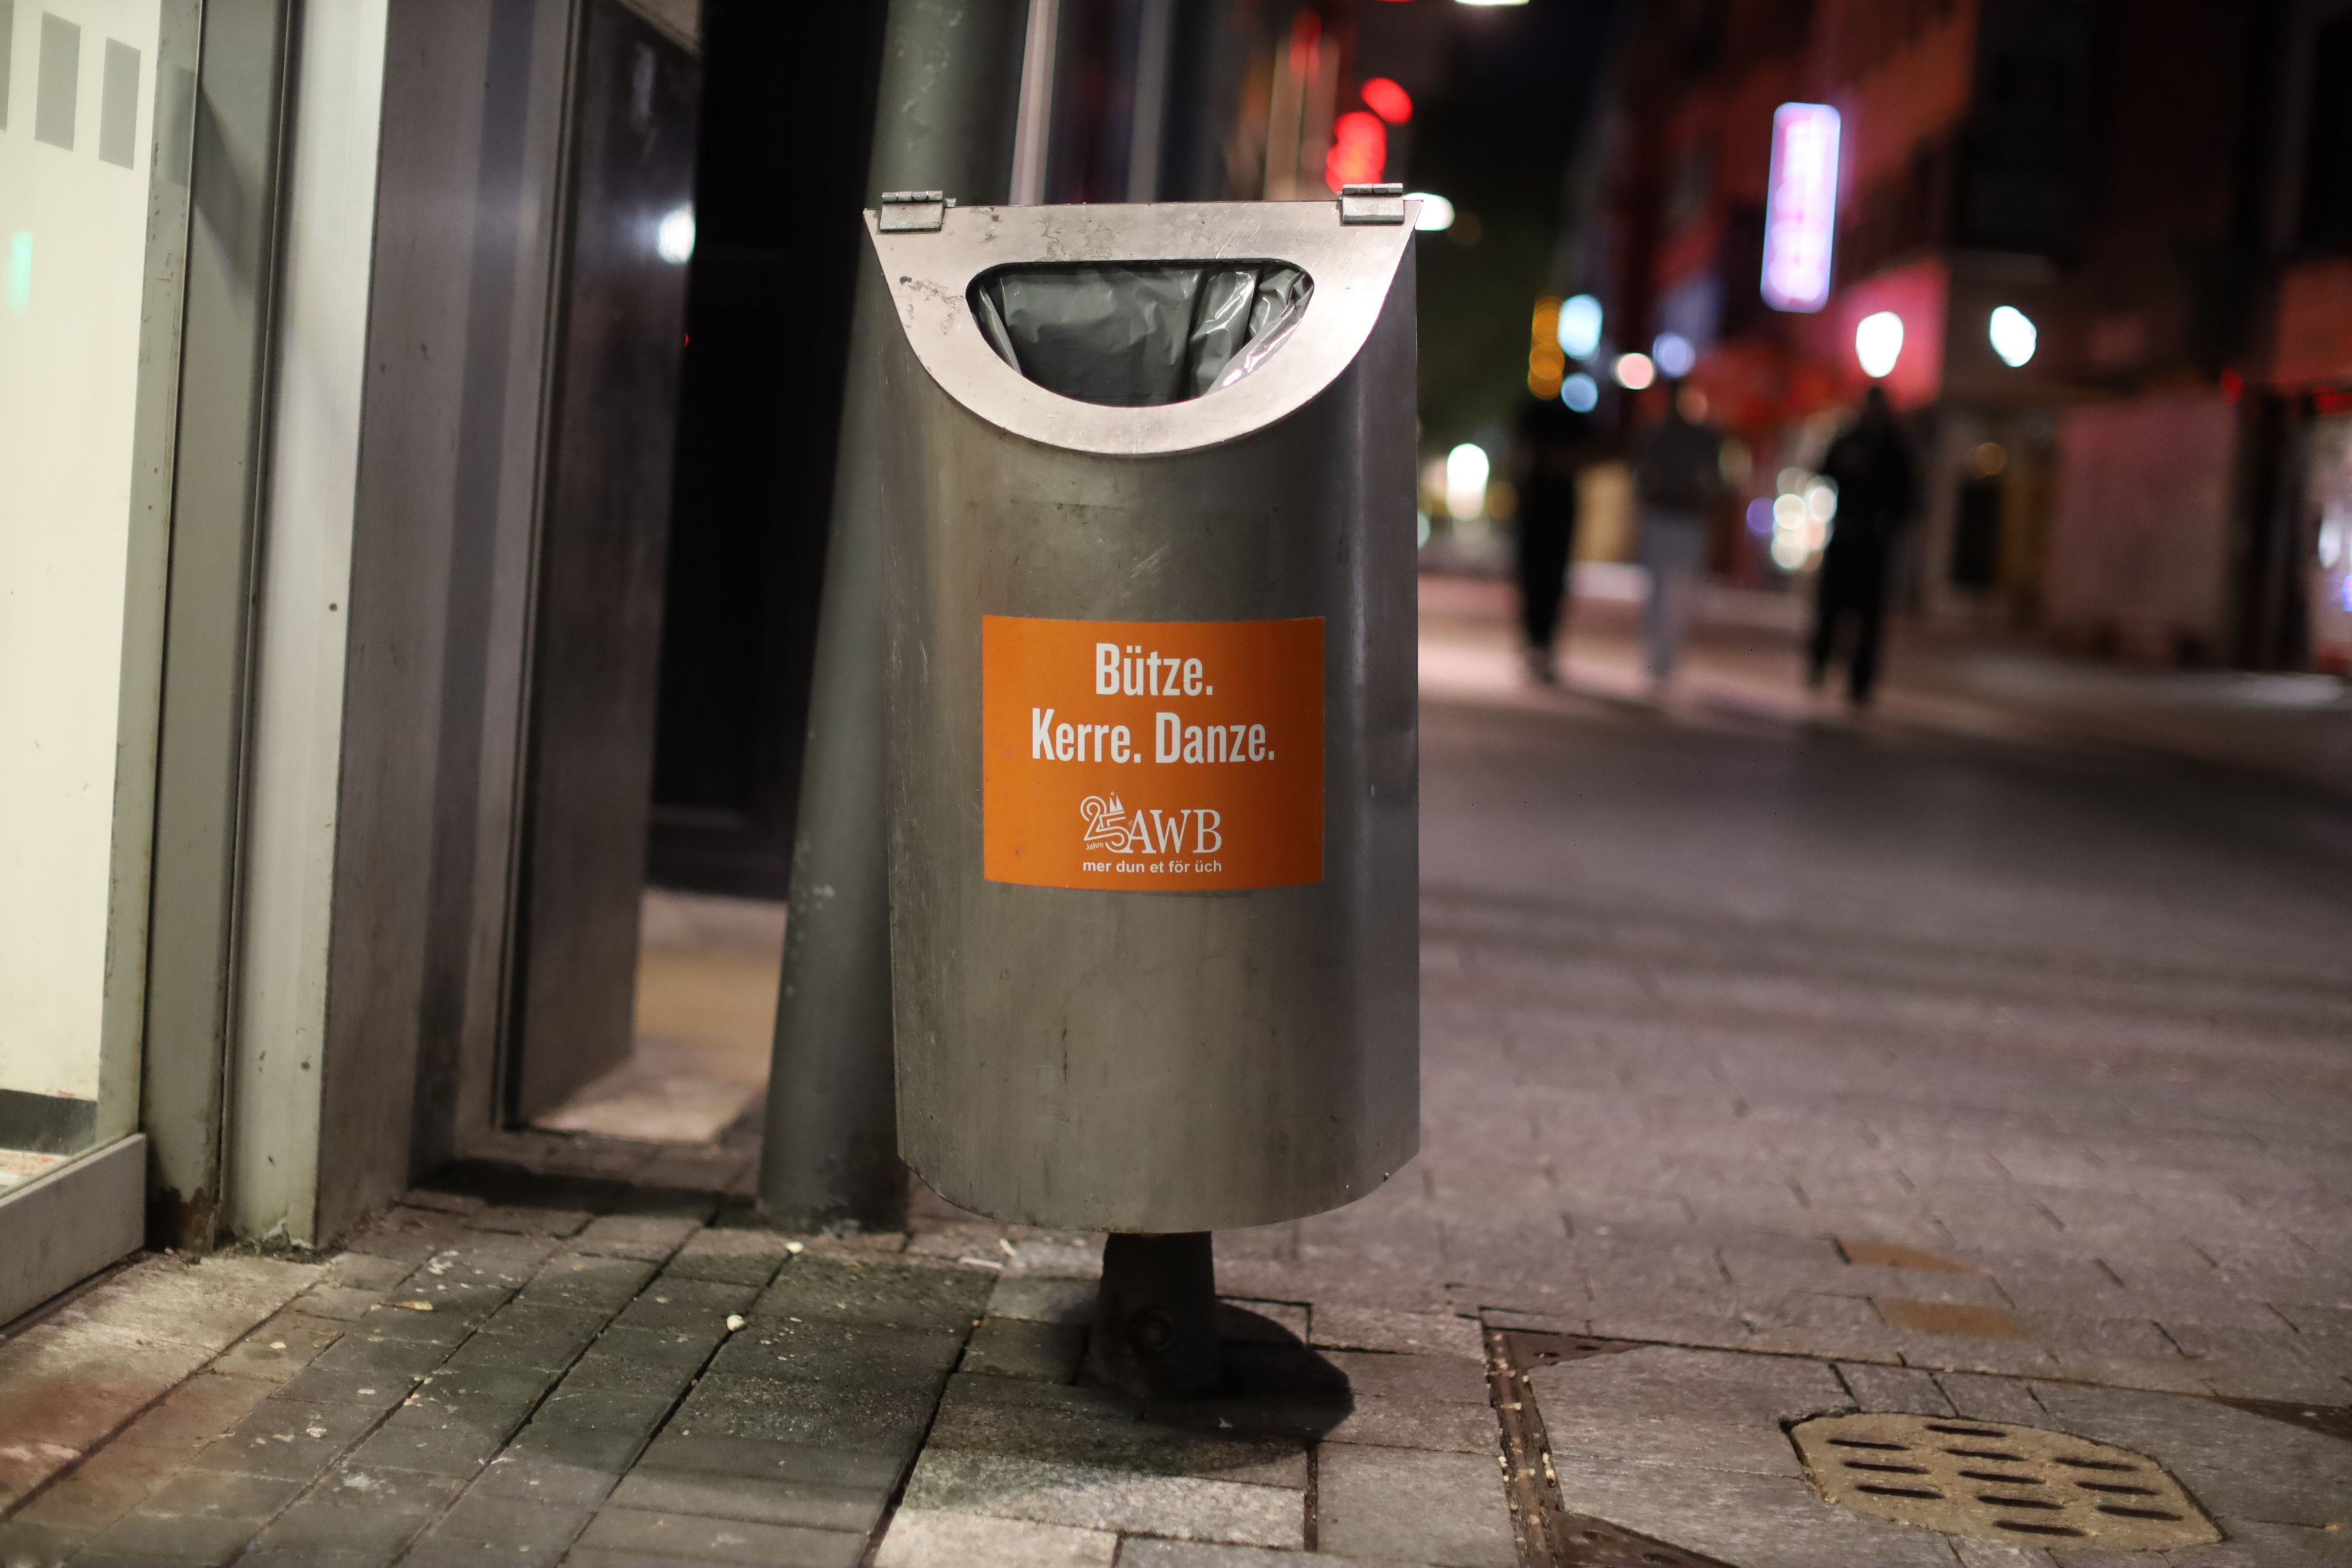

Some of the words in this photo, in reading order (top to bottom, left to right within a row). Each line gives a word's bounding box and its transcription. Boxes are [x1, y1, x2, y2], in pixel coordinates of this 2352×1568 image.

[1096, 643, 1214, 696] Bütze.
[1032, 707, 1141, 763] Kerre.
[1155, 712, 1275, 764] Danze.
[1085, 841, 1104, 851] Jahre
[1127, 809, 1222, 853] AWB
[1083, 861, 1111, 872] mer
[1116, 860, 1145, 872] dun
[1150, 861, 1164, 873] et
[1169, 860, 1190, 873] för
[1195, 860, 1222, 872] üch
